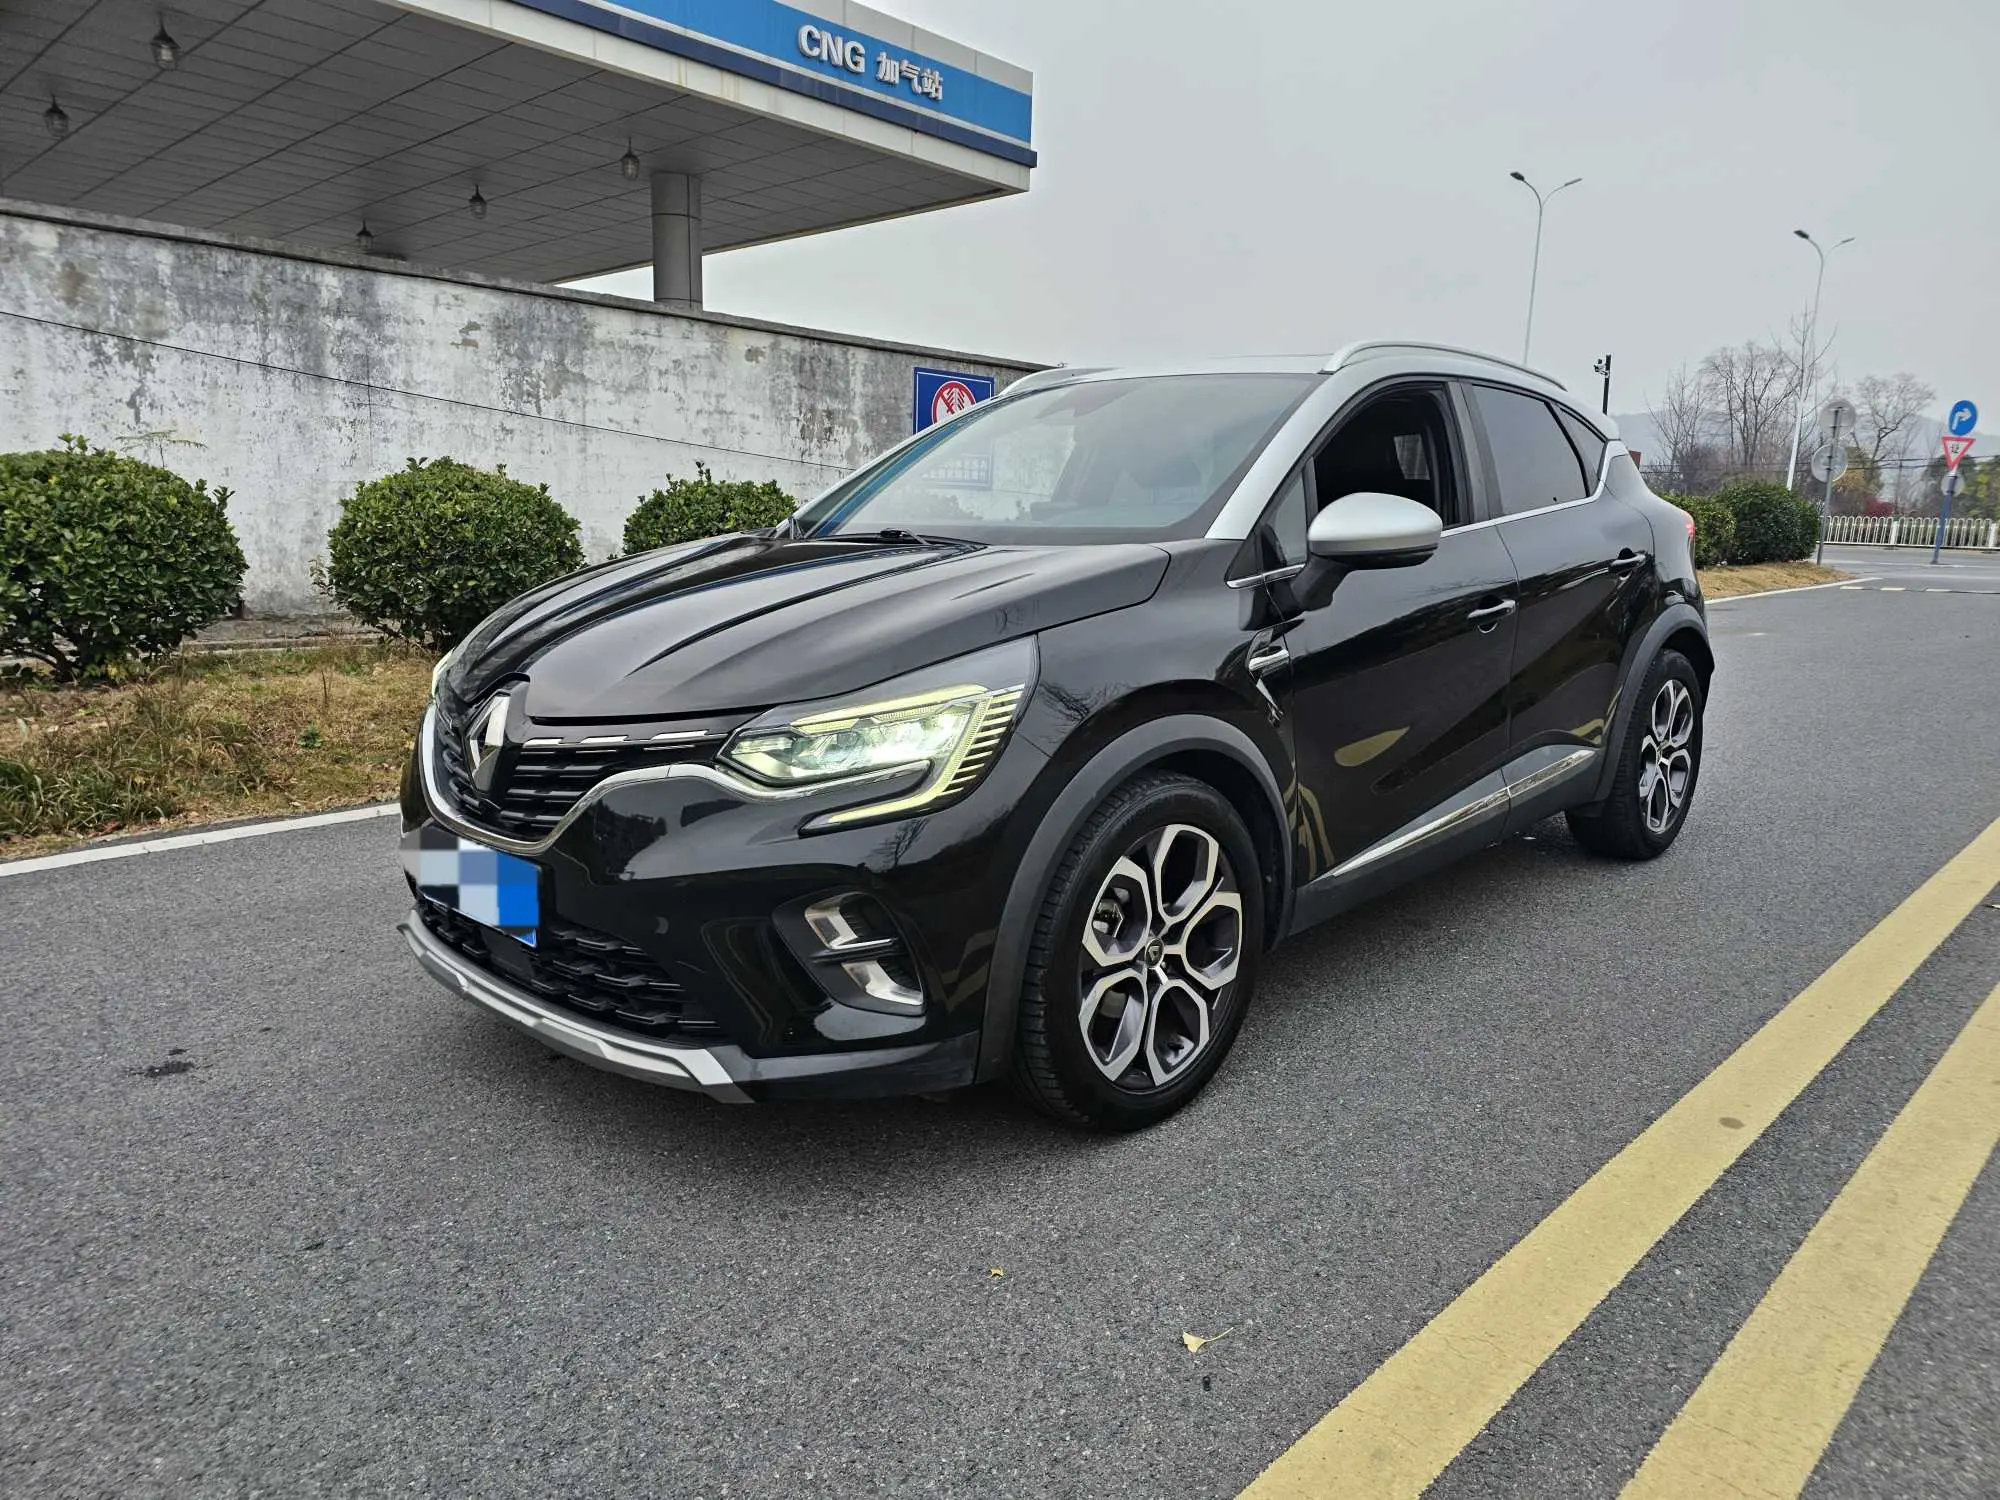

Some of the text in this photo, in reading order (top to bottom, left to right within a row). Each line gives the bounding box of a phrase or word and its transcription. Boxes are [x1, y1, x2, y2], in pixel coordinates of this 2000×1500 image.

[798, 24, 943, 100] CNG 加气站
